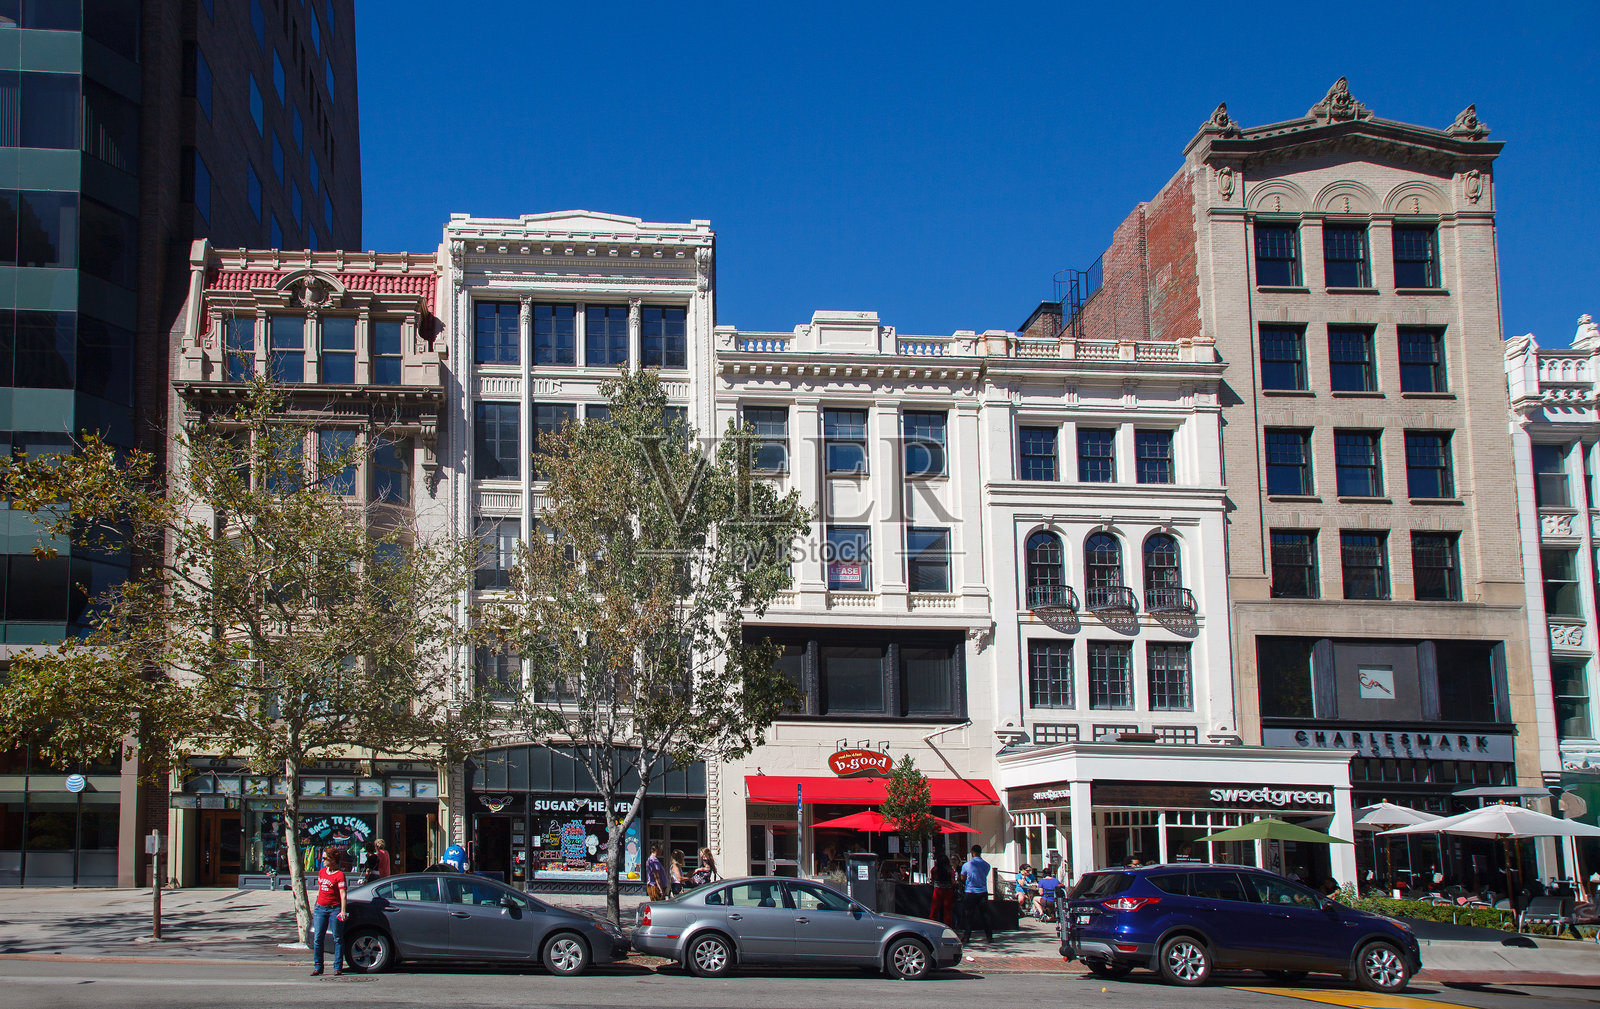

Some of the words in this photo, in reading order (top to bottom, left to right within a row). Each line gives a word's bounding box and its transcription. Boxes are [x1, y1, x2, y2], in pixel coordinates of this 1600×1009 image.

[1294, 730, 1489, 748] CHARLESMARK
[209, 759, 228, 767] 673
[397, 763, 412, 771] 671
[834, 757, 887, 771] b.good
[1210, 786, 1332, 806] sweetgreen
[534, 800, 576, 812] SUGAR
[588, 801, 633, 813] HEVEN
[308, 819, 330, 836] BACK
[330, 815, 342, 825] TO
[343, 816, 372, 838] SCHOOL
[540, 850, 561, 859] OPEN
